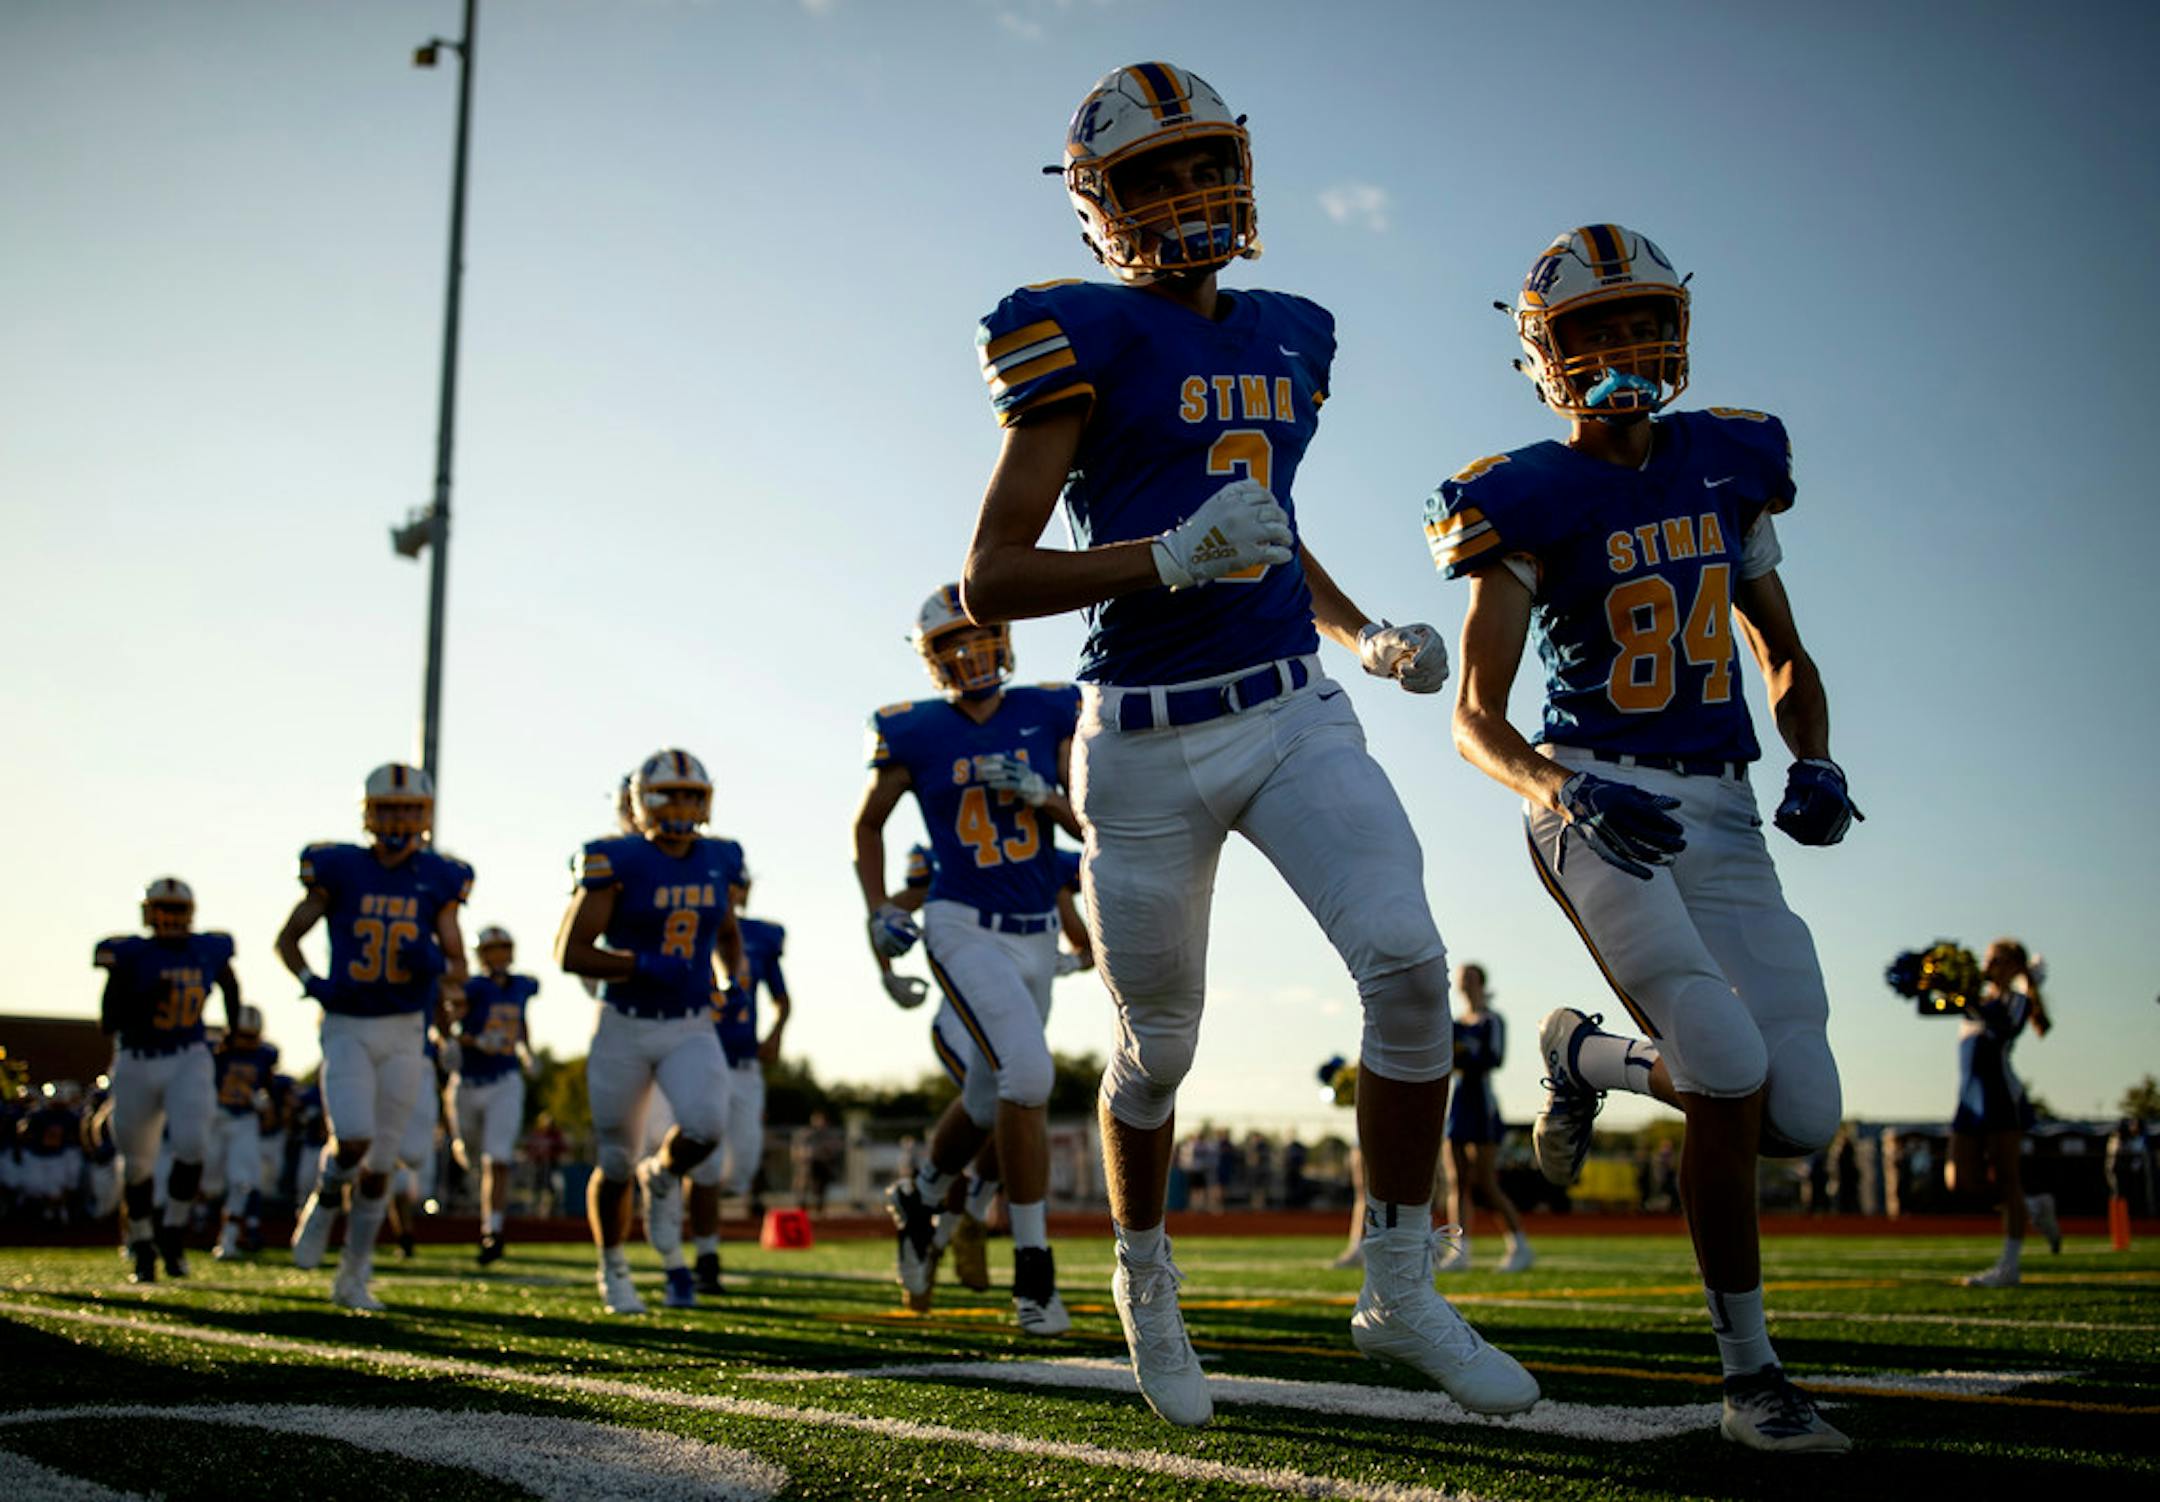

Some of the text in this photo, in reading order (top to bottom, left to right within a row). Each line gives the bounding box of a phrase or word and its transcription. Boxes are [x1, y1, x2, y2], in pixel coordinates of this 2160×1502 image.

[1179, 374, 1296, 424] STMA
[1191, 546, 1239, 565] adidas
[1606, 512, 1727, 574] STMA
[1604, 562, 1735, 714] 84
[955, 785, 1041, 868] 43
